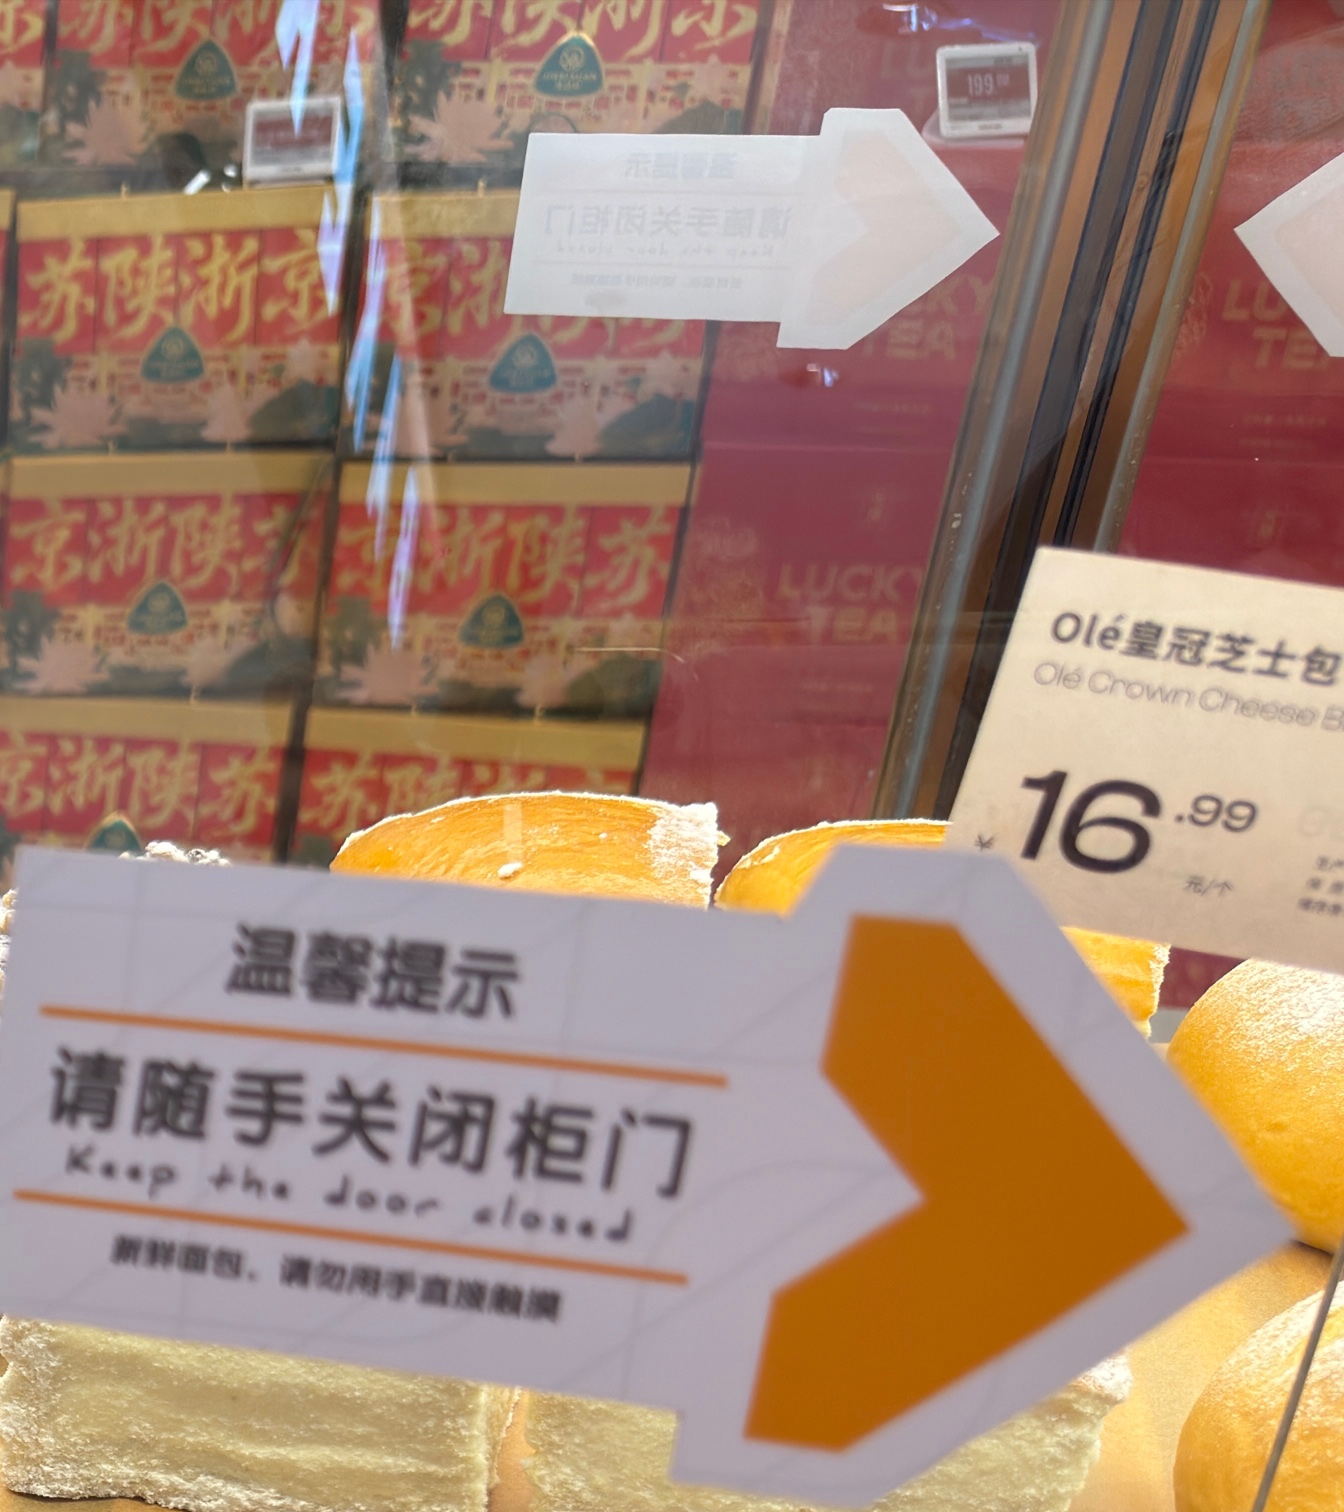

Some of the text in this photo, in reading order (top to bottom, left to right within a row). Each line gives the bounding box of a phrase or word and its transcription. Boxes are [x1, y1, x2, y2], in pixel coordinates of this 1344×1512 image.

[1251, 326, 1330, 370] TE
[1033, 661, 1081, 690] Olé
[1087, 669, 1192, 707] Crown
[1199, 686, 1316, 727] Cheese
[1050, 611, 1342, 688] Olé皇冠芝士包
[1020, 769, 1258, 875] 16.99
[225, 921, 521, 1022] 温馨提示
[49, 1046, 694, 1203] 请随手关闭柜门
[65, 1144, 633, 1245] Keep the door closed
